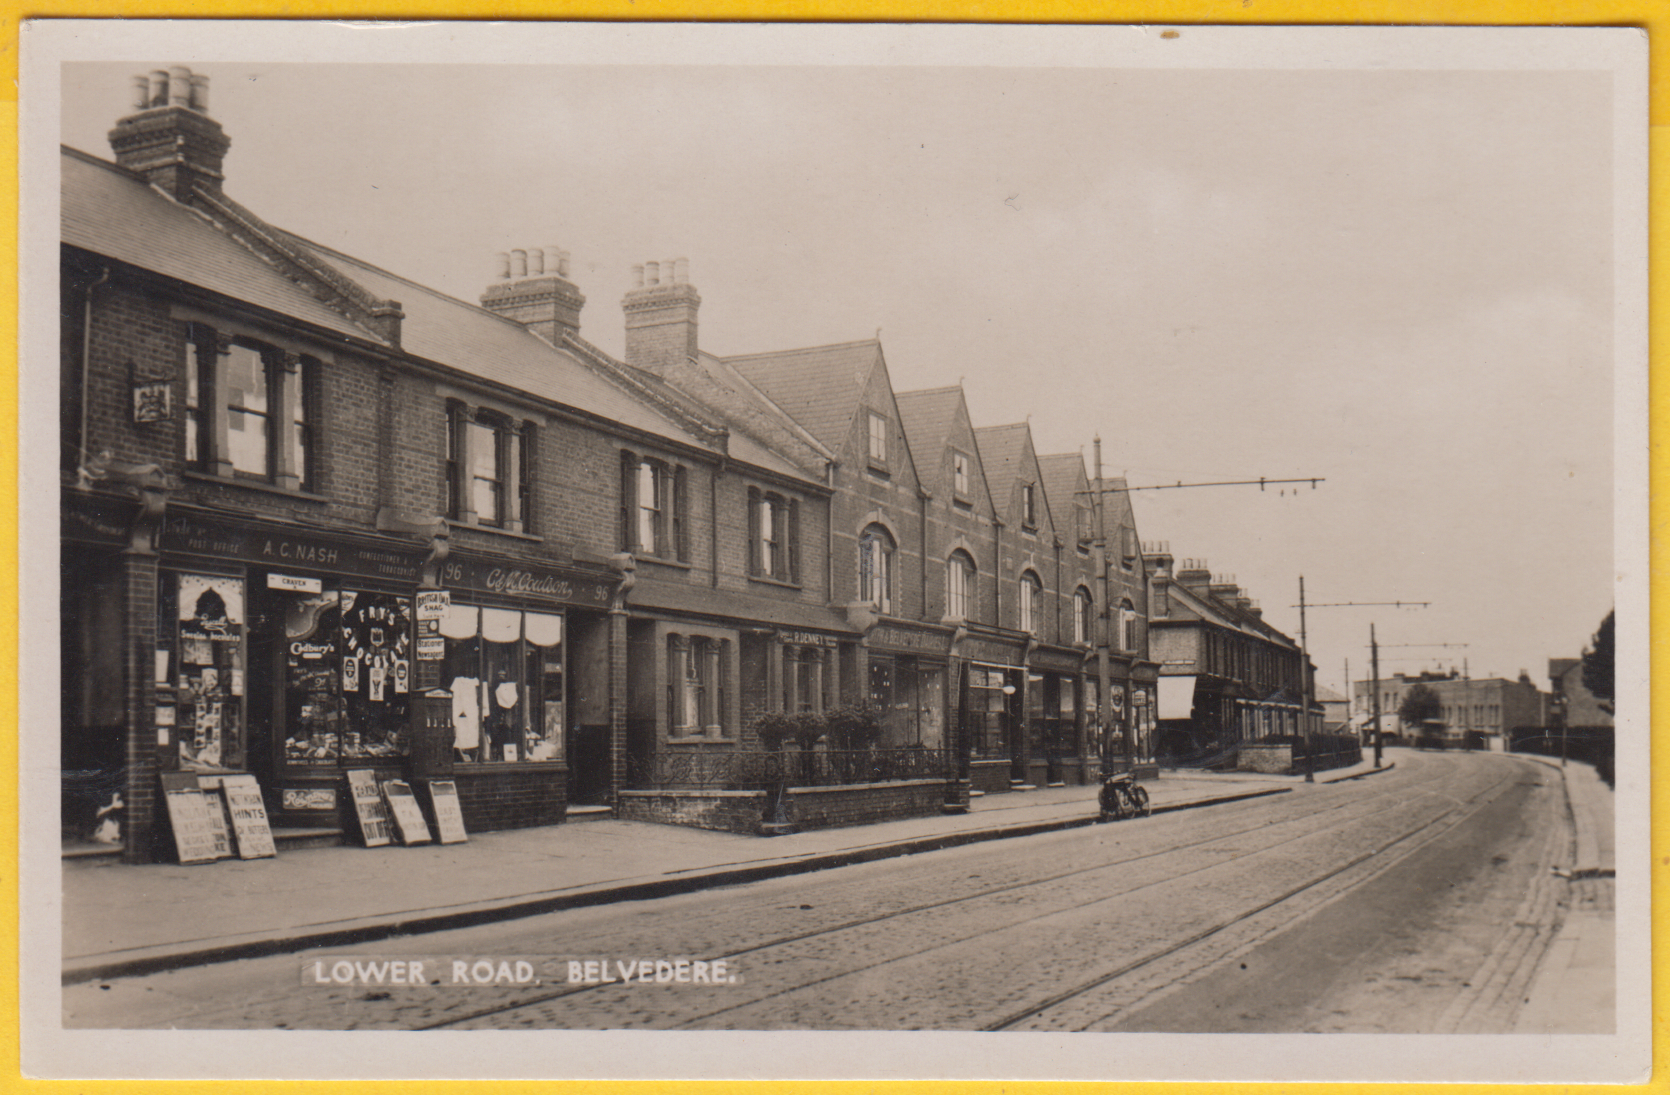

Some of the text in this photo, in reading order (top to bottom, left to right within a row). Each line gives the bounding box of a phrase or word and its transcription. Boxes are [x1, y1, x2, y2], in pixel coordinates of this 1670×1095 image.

[296, 545, 338, 564] NASH
[444, 562, 462, 581] 96
[282, 577, 307, 587] CRAVEN
[594, 584, 610, 601] 96
[417, 592, 438, 609] BRITISH
[424, 604, 444, 612] SHAG
[799, 632, 824, 645] DENNEY
[290, 641, 335, 656] Cadbury's
[233, 808, 265, 819] HINTS
